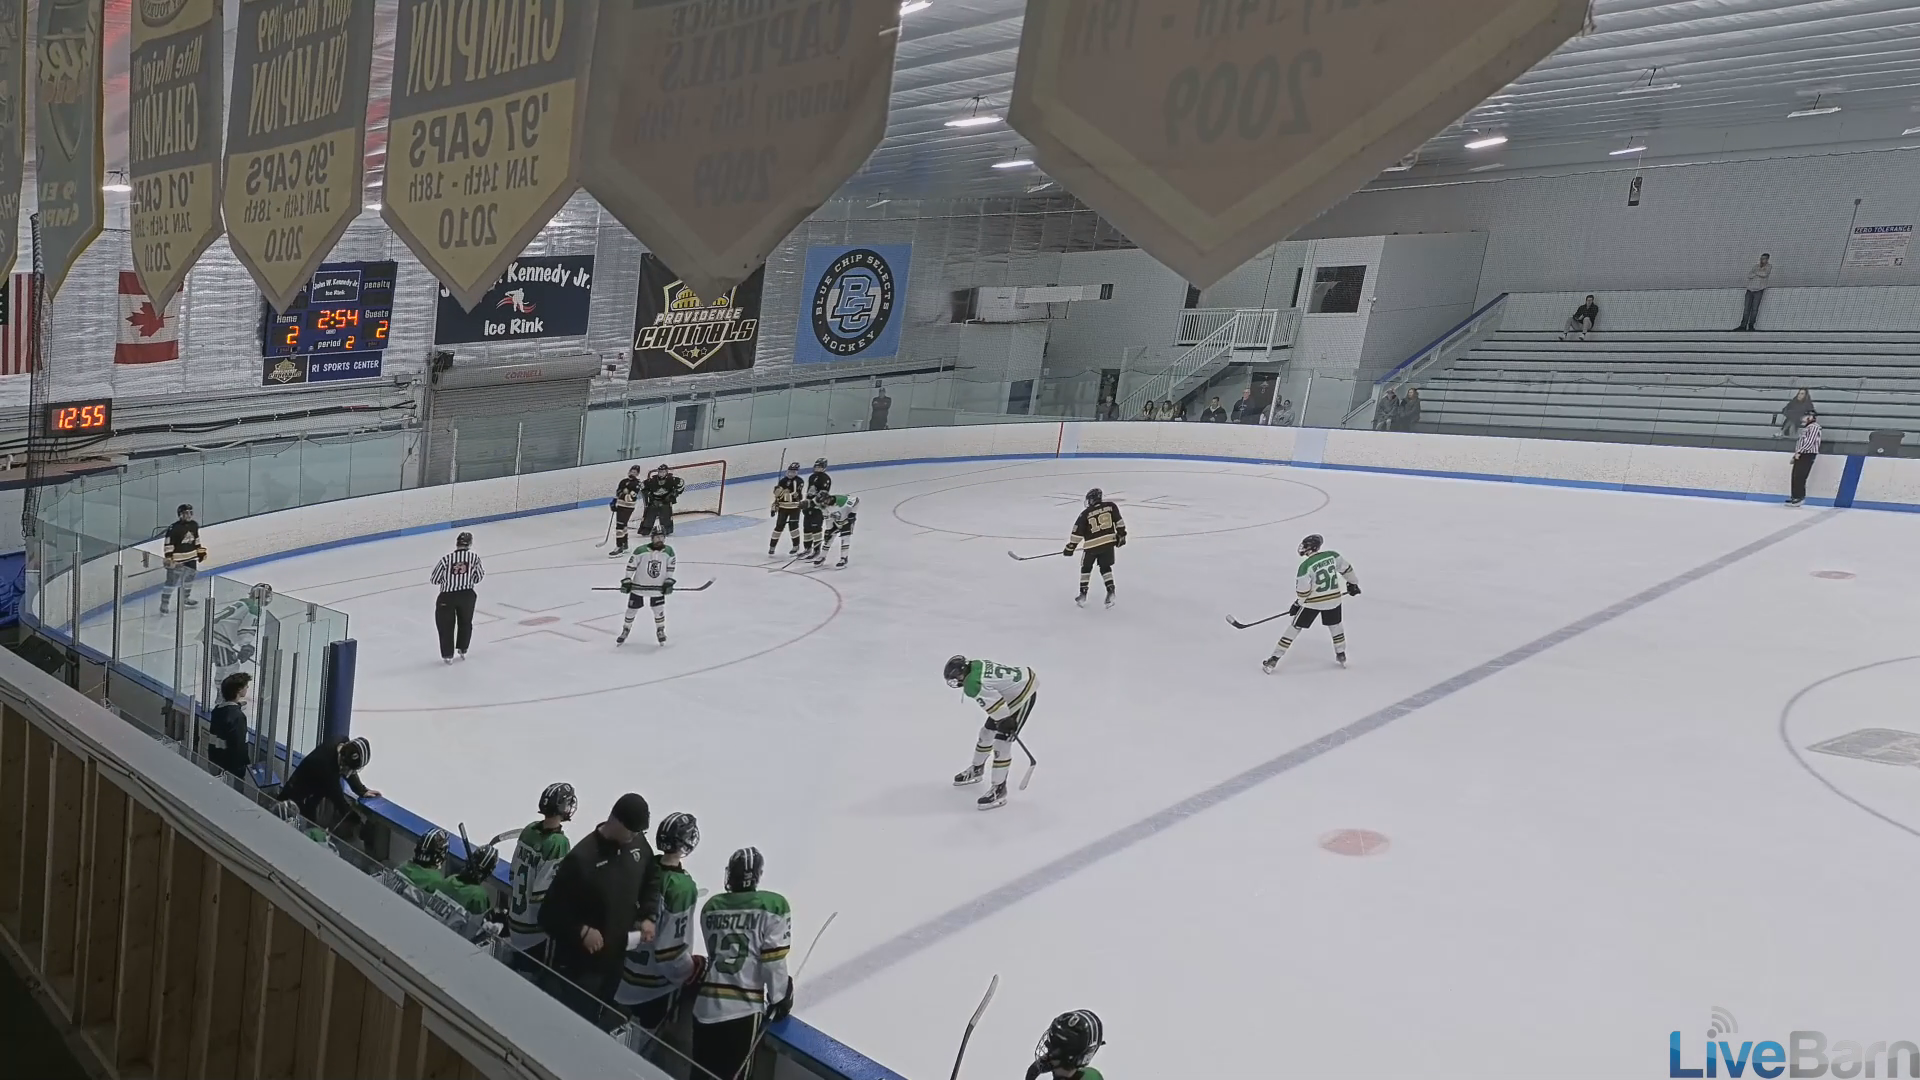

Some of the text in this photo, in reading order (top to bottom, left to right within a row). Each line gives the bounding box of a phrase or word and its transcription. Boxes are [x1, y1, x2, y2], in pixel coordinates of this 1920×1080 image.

[1874, 225, 1912, 233] TOLERANCE
[363, 280, 391, 290] penalty
[507, 261, 592, 290] Kennedy Jr.
[816, 254, 891, 316] BLUE CHIP SELECTS
[276, 314, 298, 323] Home
[317, 309, 359, 329] 2:54
[364, 310, 389, 319] Guests
[653, 306, 744, 326] PROVIDENCE
[286, 325, 300, 345] 2
[375, 320, 389, 339] 2
[483, 317, 544, 336] Ice Rink
[634, 319, 758, 353] CAPITALS
[317, 338, 342, 350] period
[345, 335, 355, 349] 2
[822, 330, 876, 352] HOCKEY
[311, 360, 380, 373] RI SPORTS CENTER
[58, 404, 105, 429] 12:55
[1088, 512, 1113, 534] 19
[1315, 564, 1339, 593] 92
[707, 932, 750, 976] 13
